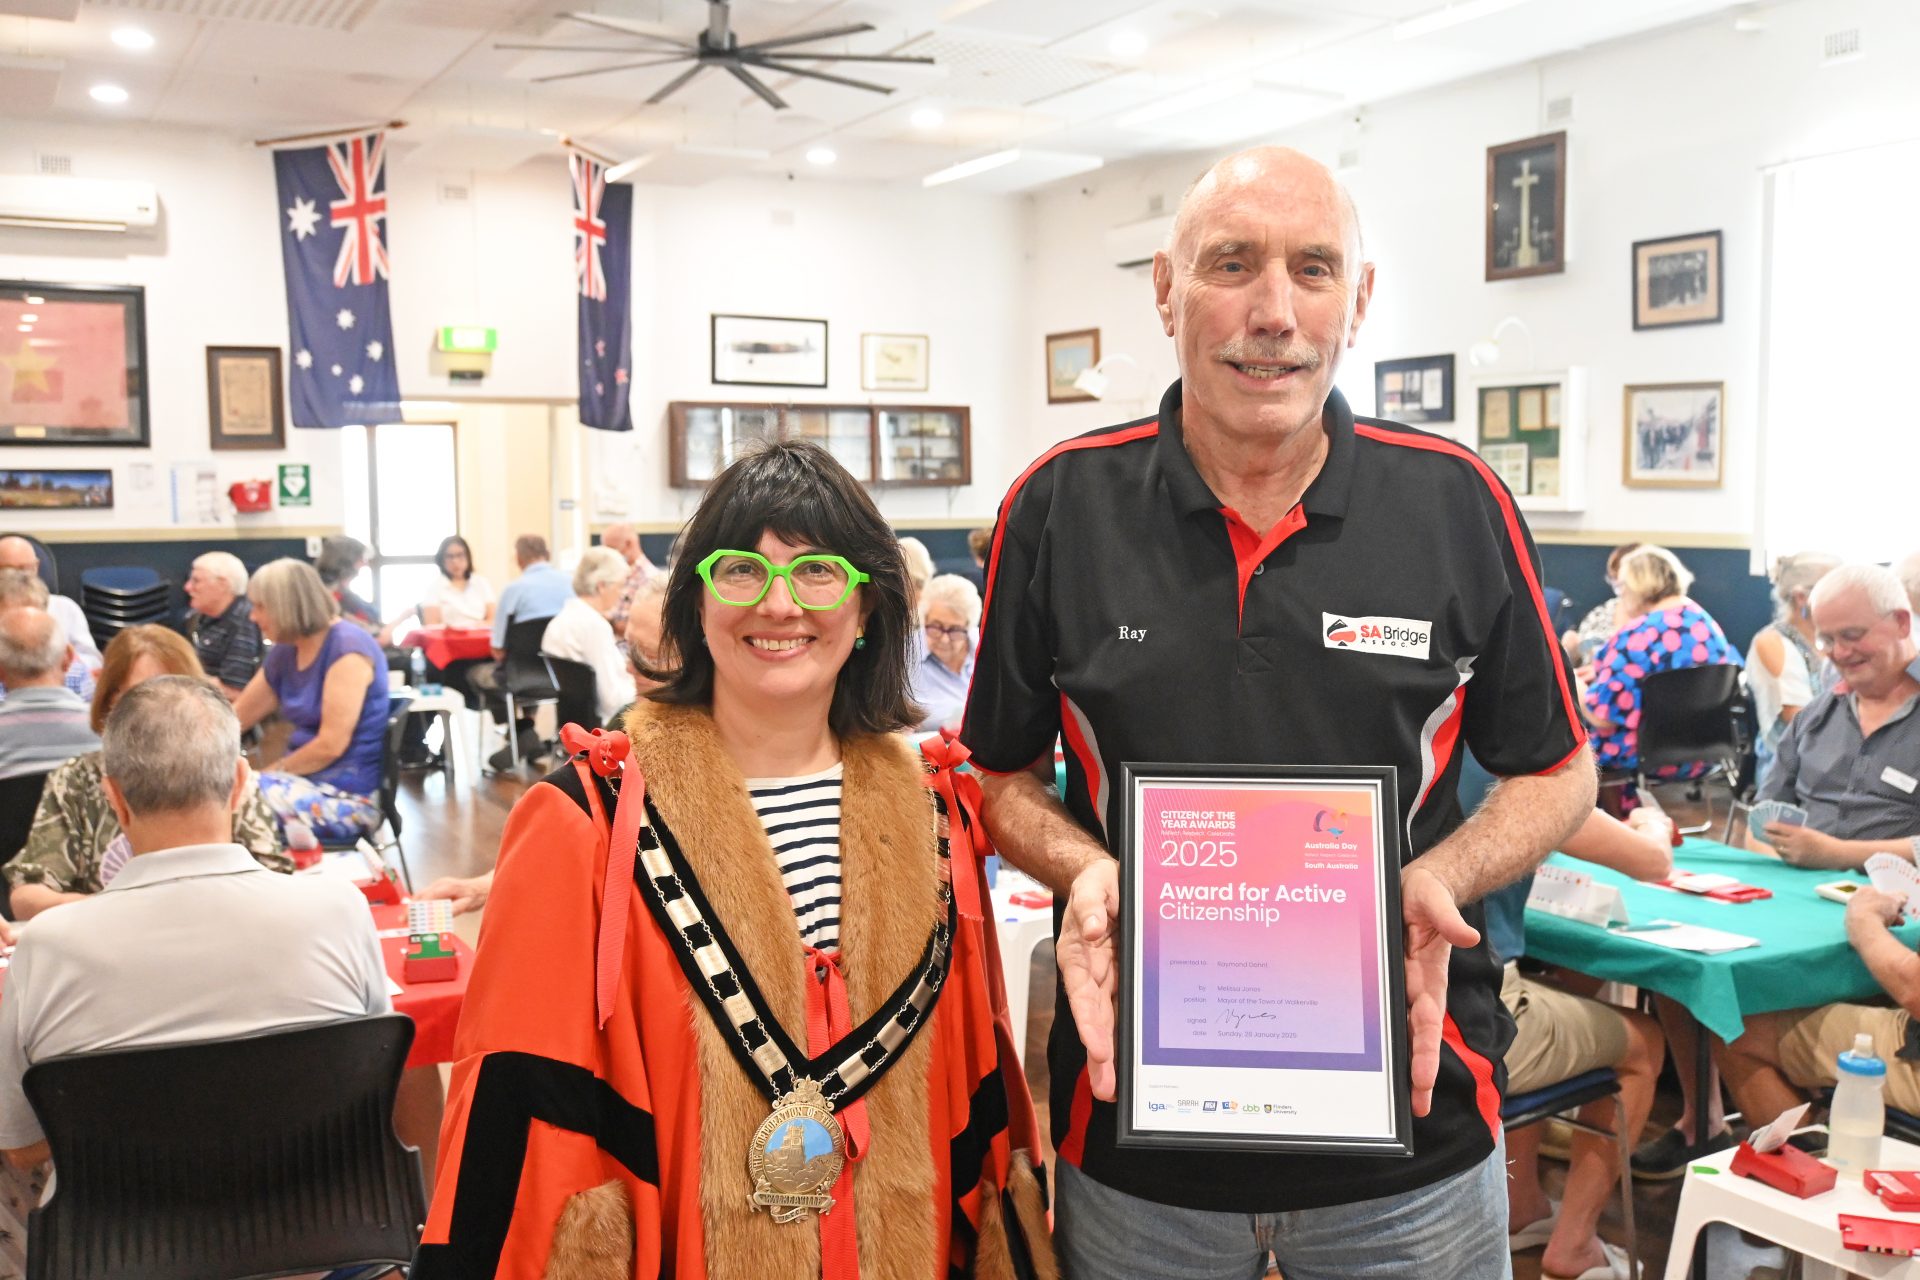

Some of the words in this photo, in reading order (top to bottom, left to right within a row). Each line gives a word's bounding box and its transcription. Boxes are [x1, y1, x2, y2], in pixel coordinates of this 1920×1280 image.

[1118, 625, 1147, 642] Ray
[1161, 811, 1199, 819] CITIZEN
[1201, 811, 1215, 819] OF
[1216, 812, 1235, 820] THE
[1161, 820, 1187, 828] YEAR
[1189, 821, 1236, 829] AWARDS
[1160, 840, 1237, 867] 2025
[1159, 882, 1233, 900] Award
[1238, 882, 1269, 901] for
[1275, 884, 1347, 903] Active
[1159, 901, 1280, 927] Citizenship
[1254, 1031, 1280, 1039] January
[807, 1108, 816, 1117] OF
[754, 1106, 802, 1150] CORPORATION
[753, 1155, 763, 1173] THE
